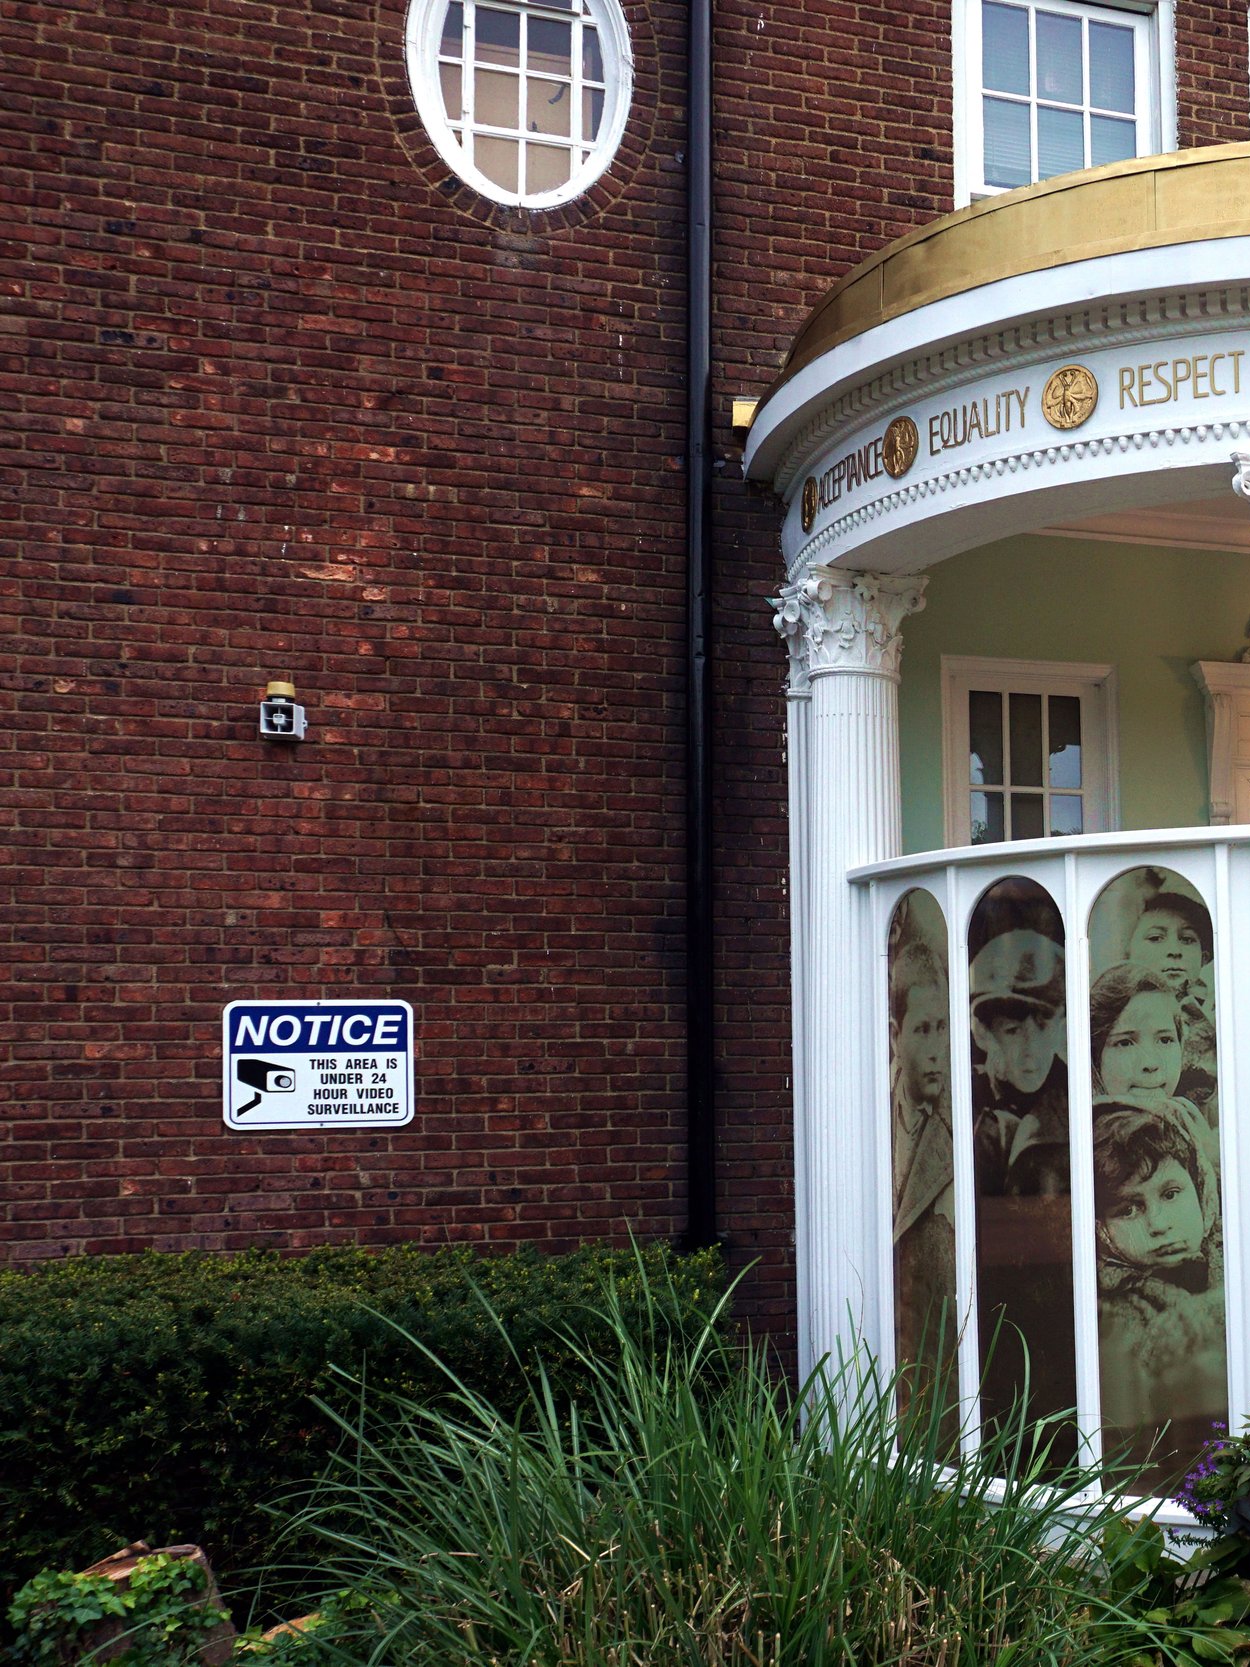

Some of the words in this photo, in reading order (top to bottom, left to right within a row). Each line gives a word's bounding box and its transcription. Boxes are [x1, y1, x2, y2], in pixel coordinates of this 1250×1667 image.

[817, 436, 884, 514] ACCEPTANCE
[929, 386, 1030, 456] EQUALITY
[1119, 350, 1245, 409] RESPECT
[234, 1014, 402, 1046] NOTICE
[309, 1059, 337, 1070] THIS
[345, 1059, 378, 1070] AREA
[386, 1058, 398, 1069] IS
[320, 1073, 363, 1084] UNDER
[371, 1073, 387, 1084] 24
[313, 1088, 348, 1100] HOUR
[356, 1088, 393, 1099] VIDEO
[307, 1103, 399, 1115] SURVEILLANCE
